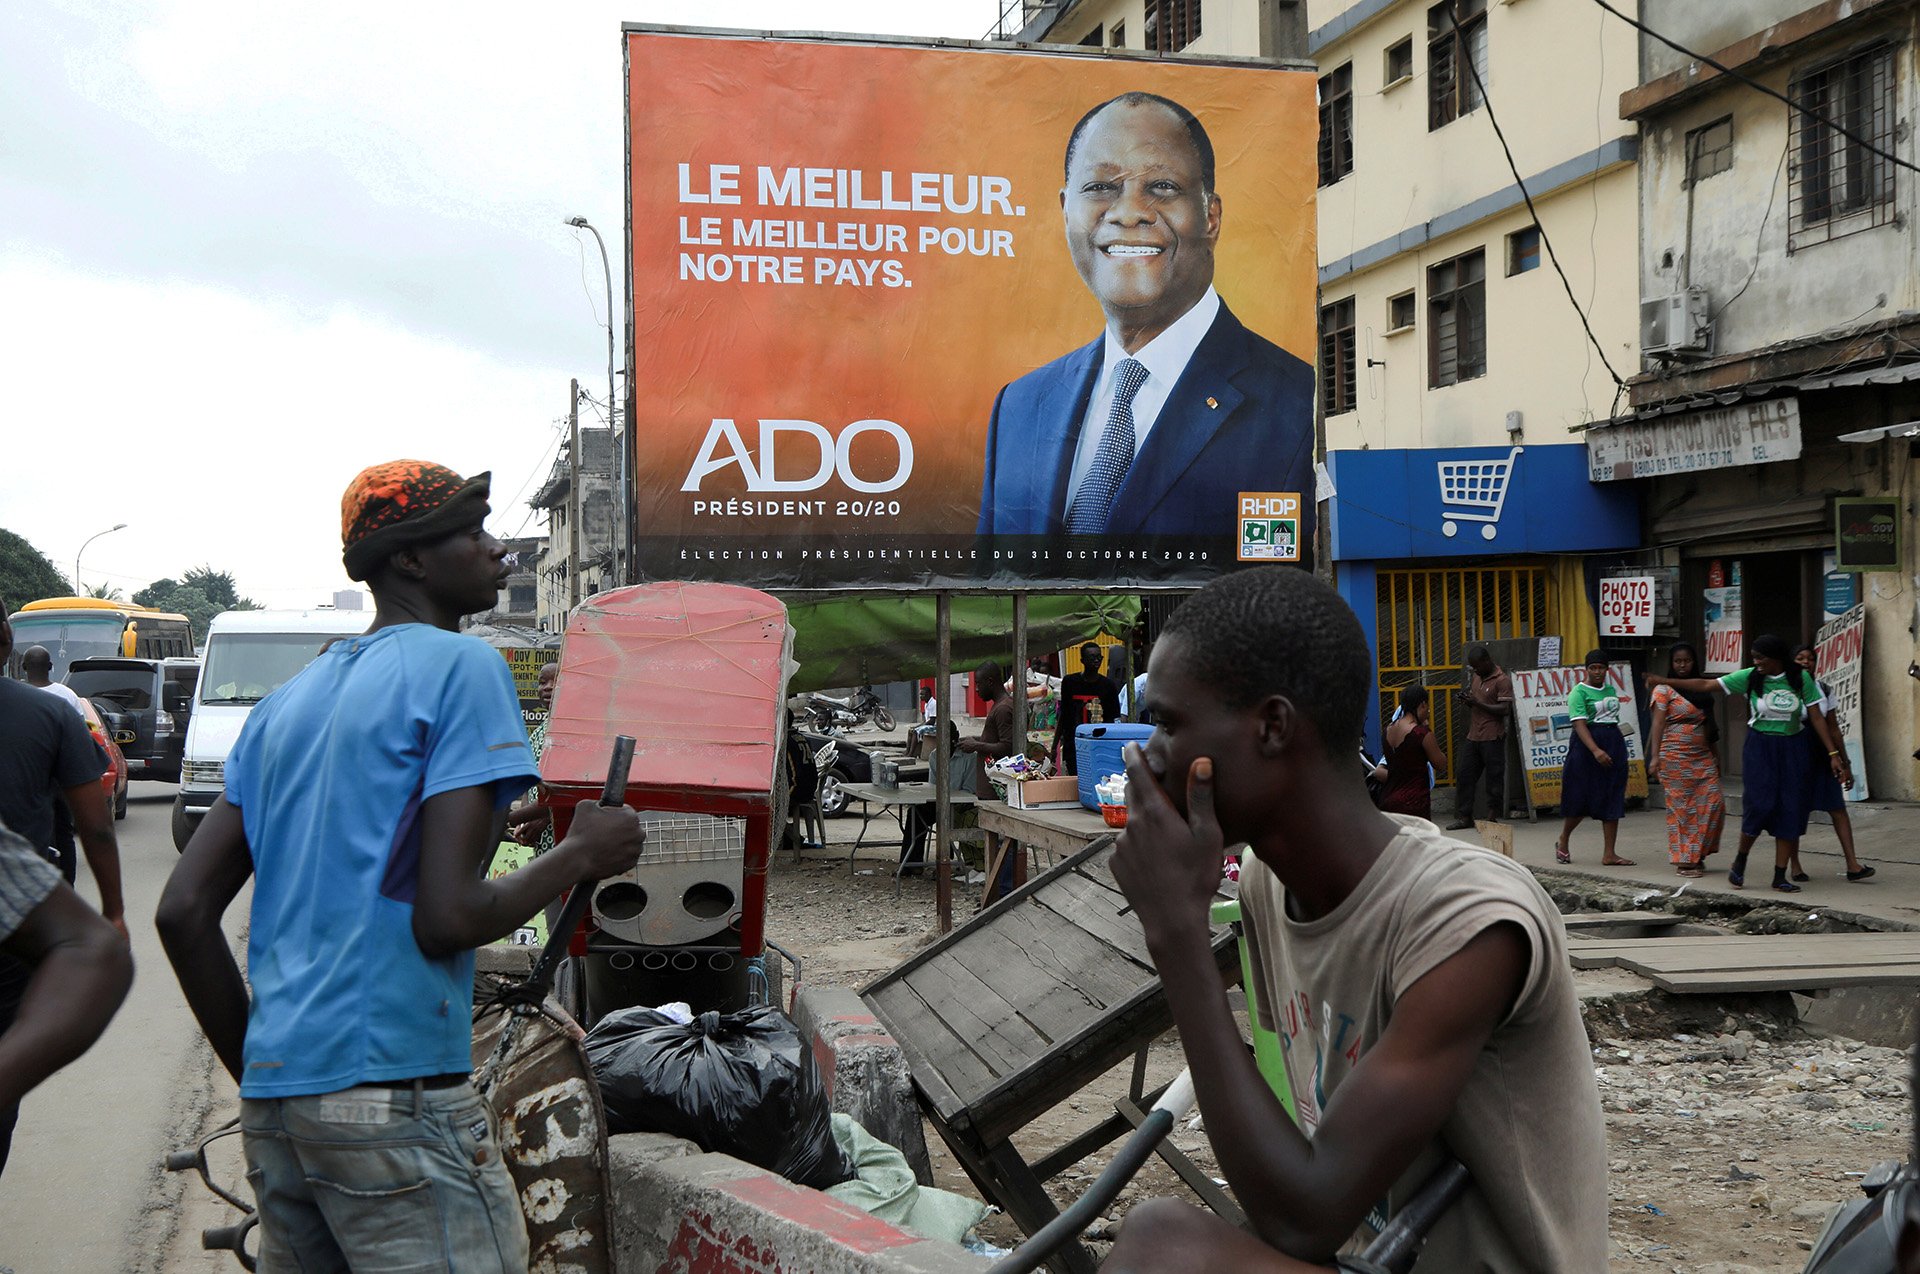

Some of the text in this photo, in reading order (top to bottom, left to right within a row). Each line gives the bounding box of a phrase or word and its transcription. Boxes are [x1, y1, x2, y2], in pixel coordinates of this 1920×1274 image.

[679, 162, 1026, 217] LE MEILLEUR.
[679, 216, 1016, 258] LE MEILLEUR POUR
[679, 252, 913, 288] NOTRE PAYS.
[680, 418, 915, 494] ADO
[1604, 466, 1613, 480] BP
[694, 498, 901, 517] PRÉSIDENT 20/20
[1241, 497, 1297, 516] RHDP
[680, 548, 1208, 561] ÉLECTION PRÉSIDENTIELLE DU 31 OCTOBRE 2020
[1601, 581, 1649, 601] PHOTO
[1601, 600, 1651, 617] COPIE
[1708, 630, 1744, 663] OUVERT
[1516, 664, 1627, 699] TAMPN
